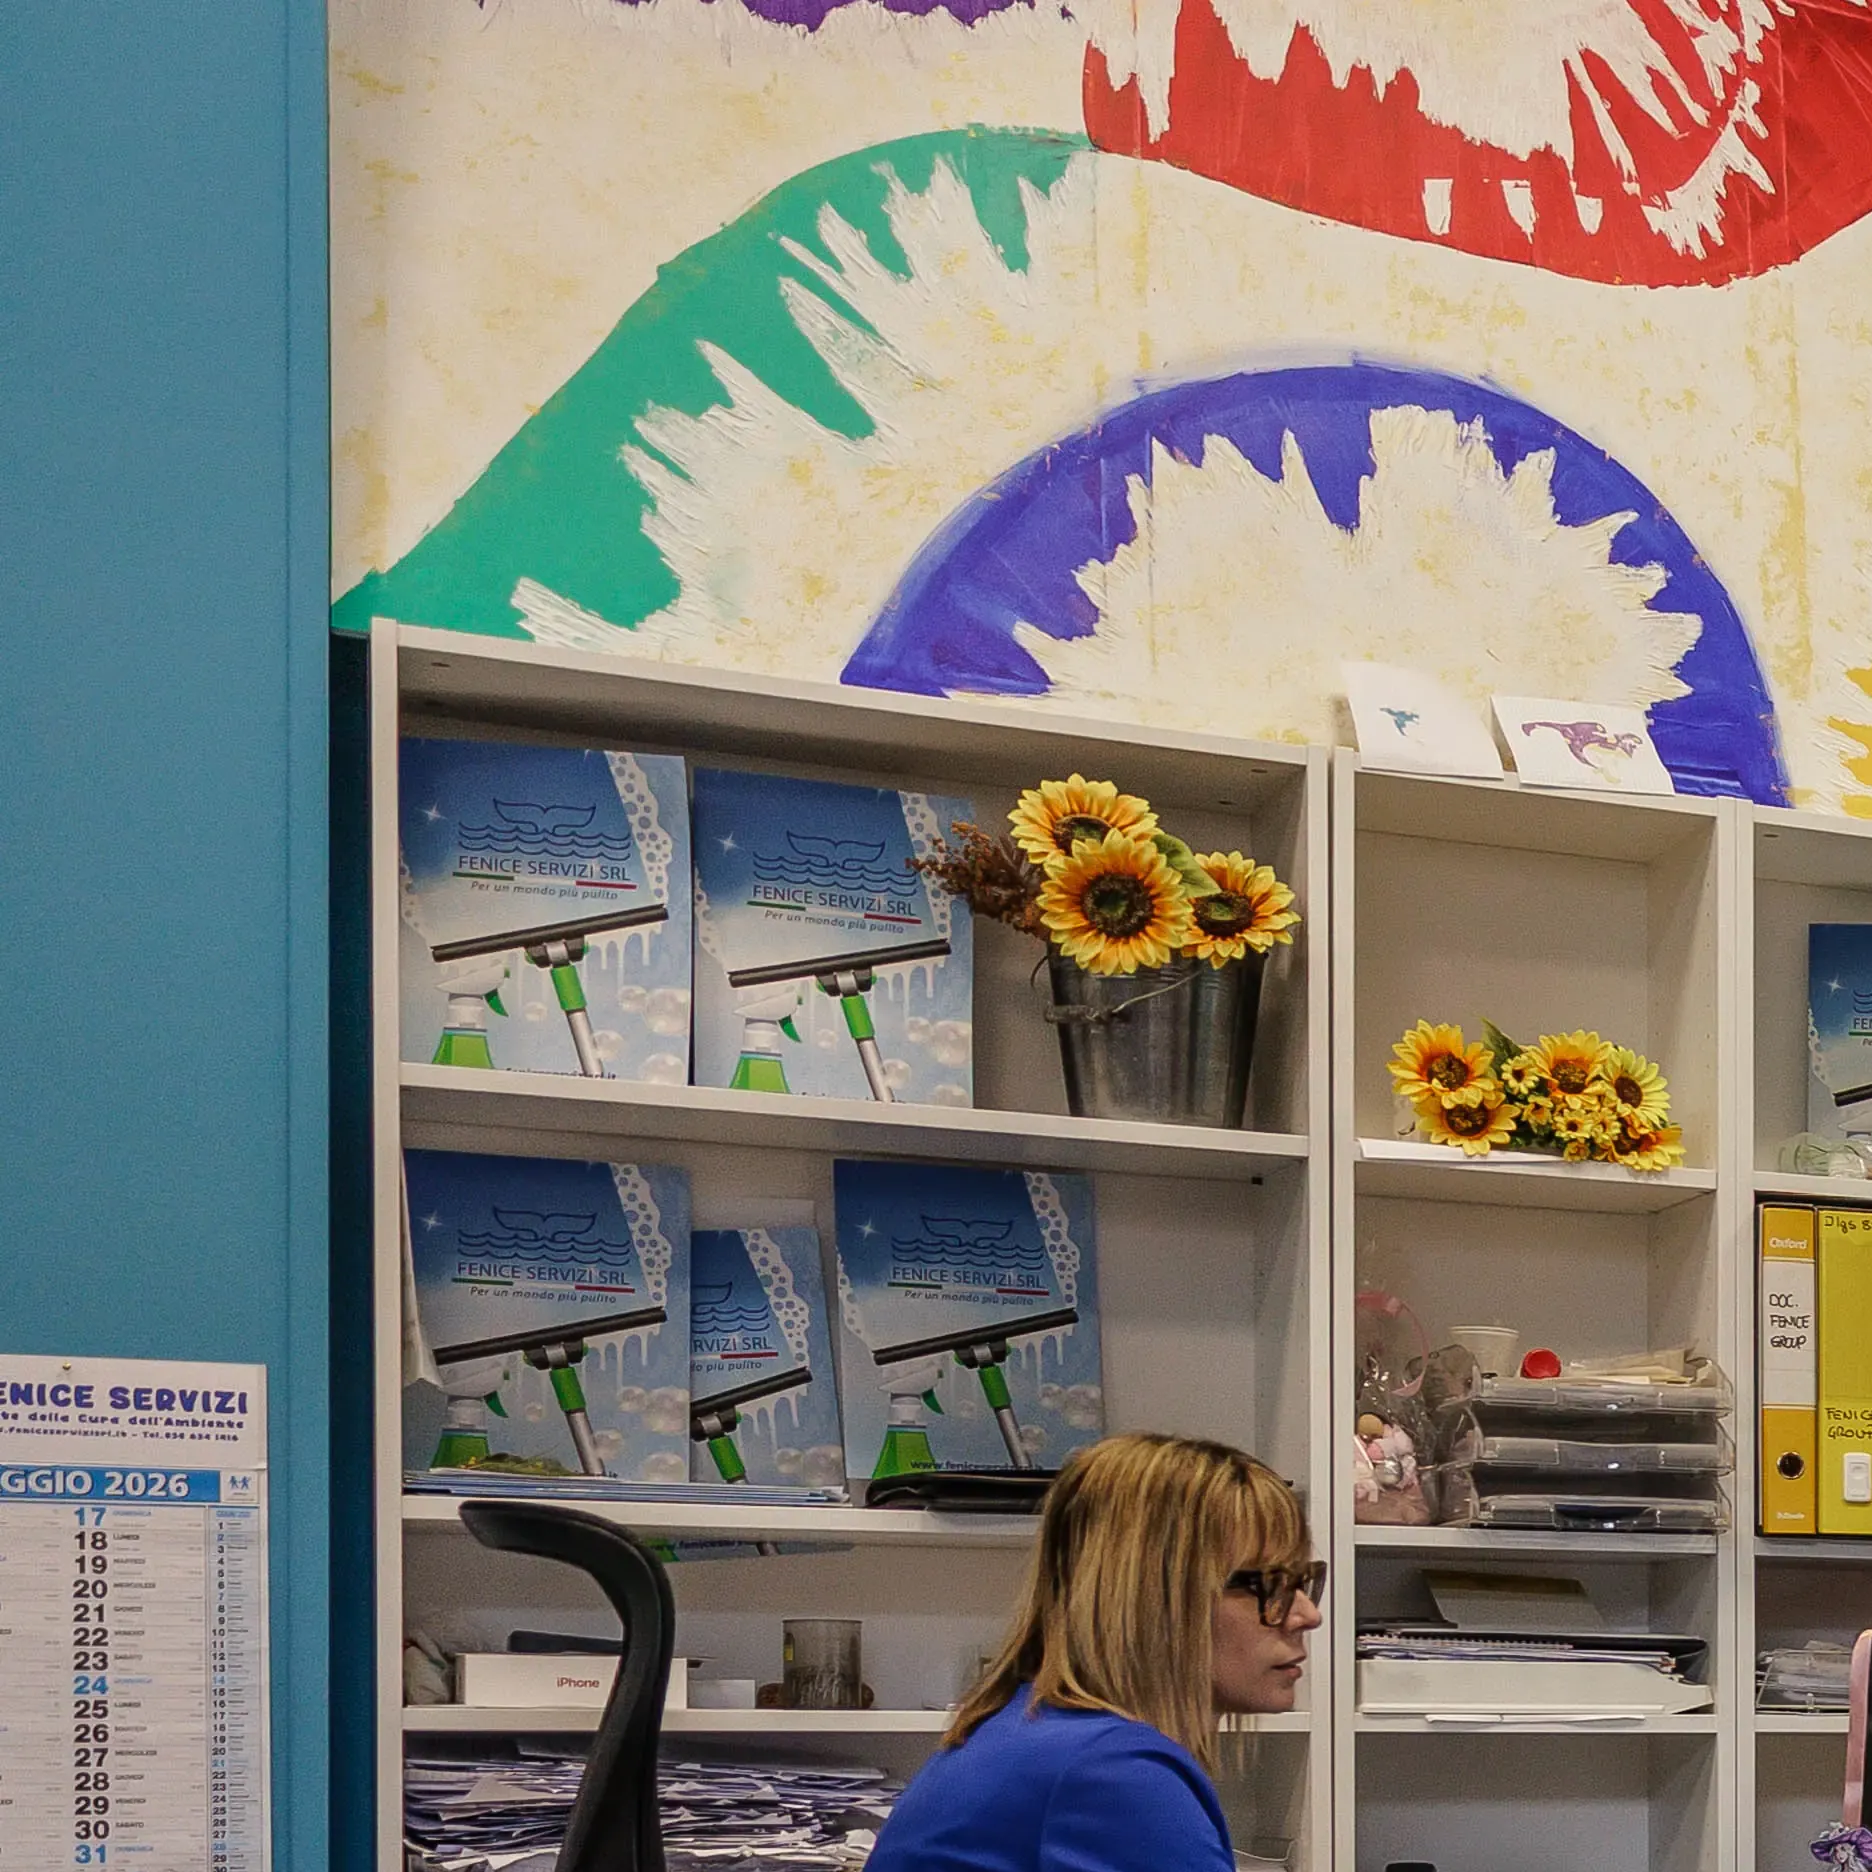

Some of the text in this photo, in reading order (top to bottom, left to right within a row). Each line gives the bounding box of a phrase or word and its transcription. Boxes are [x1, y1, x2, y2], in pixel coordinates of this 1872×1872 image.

[459, 856, 630, 881] FENICE SERVIZI SRL
[471, 881, 618, 900] Per un mondo più pulito
[753, 885, 916, 916] FENICE SERVIZI SRL
[765, 910, 783, 920] Per
[805, 916, 844, 927] mondo
[848, 920, 866, 930] più
[869, 922, 904, 933] pulito
[1769, 1238, 1807, 1249] Oxford
[458, 1263, 630, 1284] FENICE SERVIZI SRL
[893, 1267, 1045, 1288] FENICE SERVIZI SRL
[471, 1287, 488, 1296] Per
[513, 1289, 553, 1300] mondo
[558, 1292, 576, 1302] più
[581, 1295, 616, 1303] pulito
[1769, 1294, 1799, 1308] DOC.
[1770, 1315, 1810, 1329] FENICE
[742, 1337, 772, 1350] SRL
[1770, 1336, 1806, 1349] GROUP
[728, 1361, 761, 1372] pulito
[109, 1386, 248, 1414] SERVIZI
[28, 1411, 70, 1422] della
[78, 1414, 119, 1424] Cura
[0, 1469, 189, 1497] GGIO 2026
[74, 1507, 106, 1526] 17
[74, 1531, 108, 1550] 18
[74, 1555, 108, 1574] 19
[73, 1580, 108, 1598] 20
[73, 1604, 105, 1622] 21
[73, 1628, 108, 1646] 22
[73, 1652, 108, 1671] 23
[73, 1676, 108, 1695] 24
[557, 1677, 599, 1688] iPhone
[74, 1700, 108, 1719] 25
[74, 1724, 109, 1742] 26
[74, 1748, 109, 1767] 27
[75, 1772, 109, 1791] 28
[75, 1796, 109, 1815] 29
[75, 1821, 109, 1839] 30
[75, 1845, 106, 1863] 31
